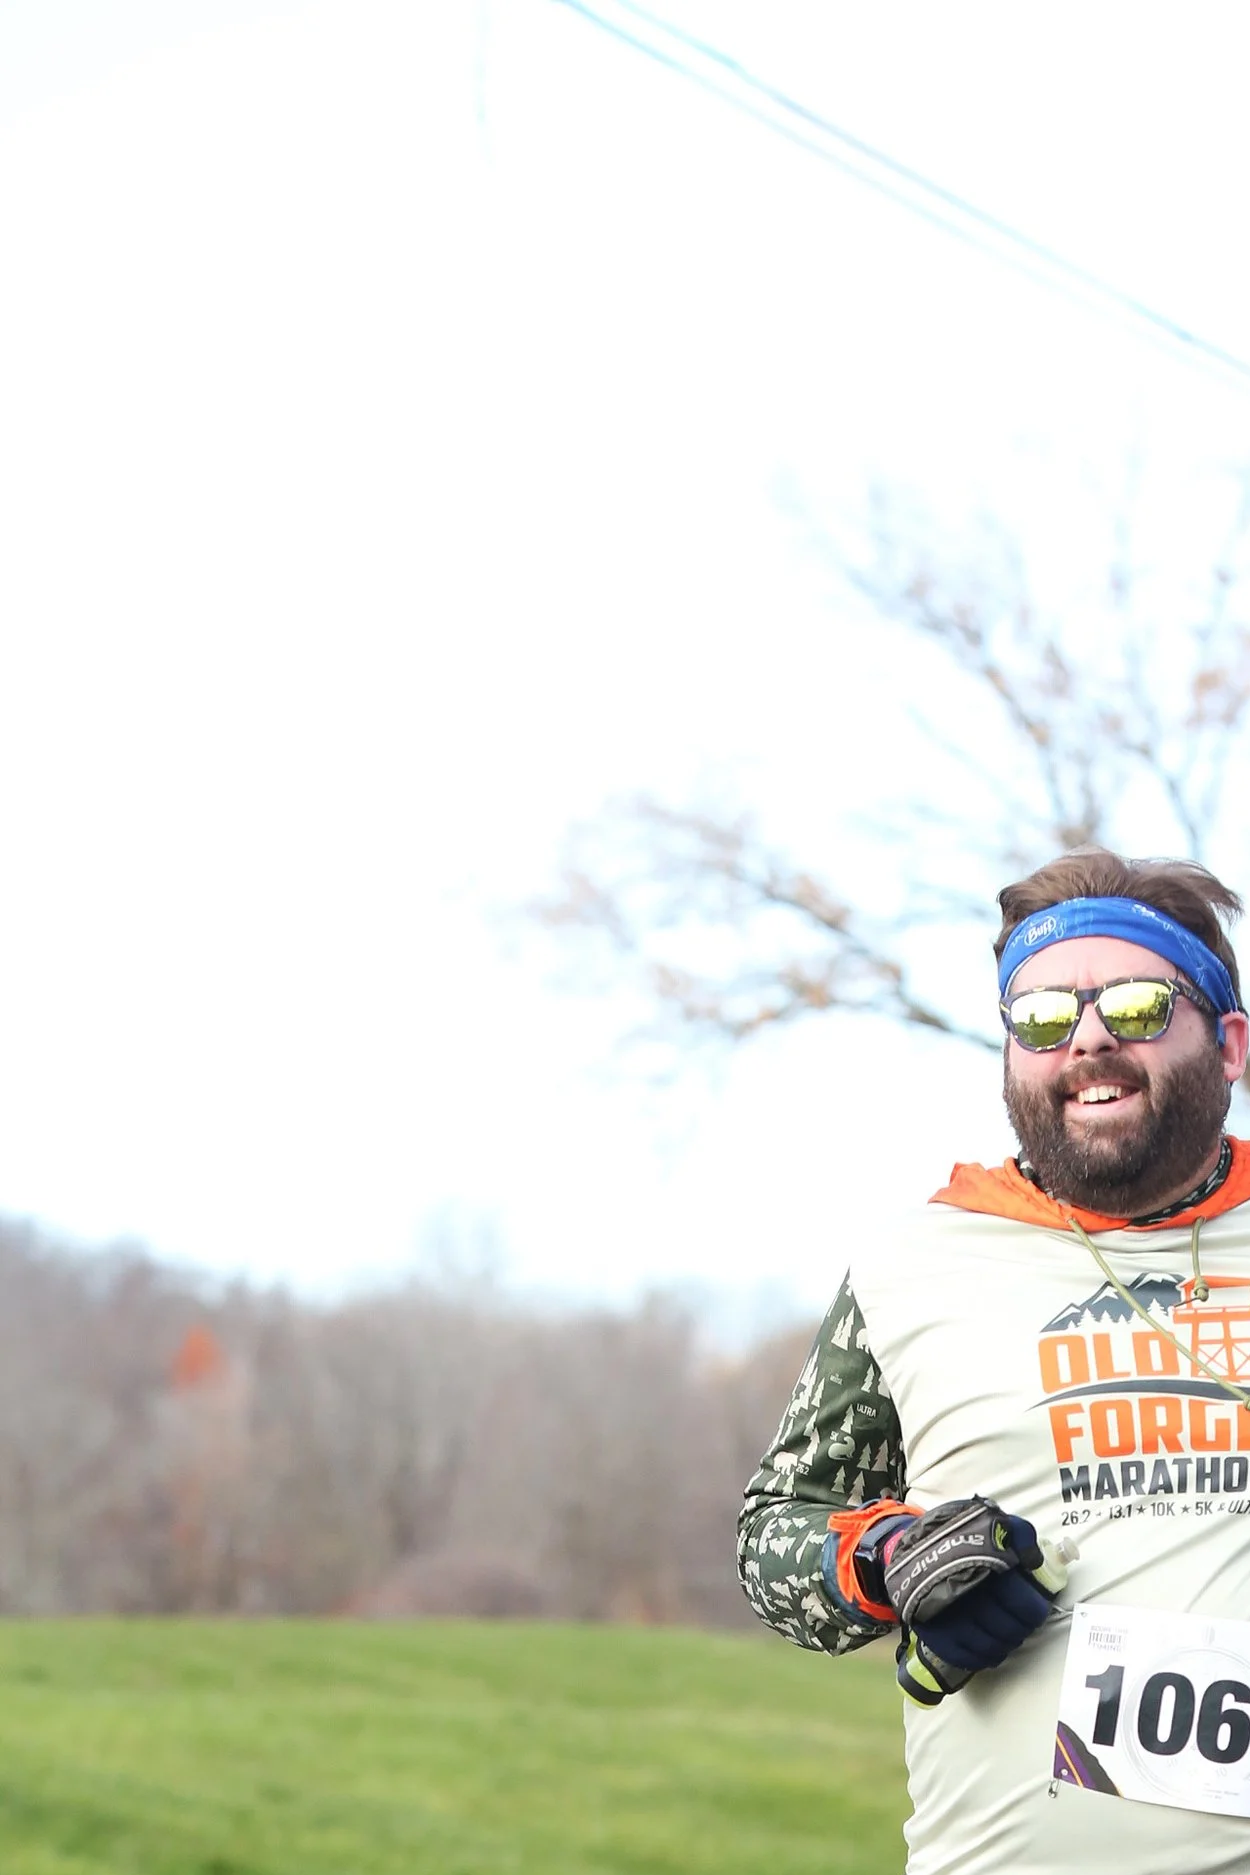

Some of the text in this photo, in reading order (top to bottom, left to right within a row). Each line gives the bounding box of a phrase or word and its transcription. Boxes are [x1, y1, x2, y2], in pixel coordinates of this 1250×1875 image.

[1038, 1332, 1181, 1394] OLD
[1109, 1504, 1133, 1520] 13.1
[1151, 1501, 1176, 1517] 10K
[1195, 1500, 1213, 1516] 5K
